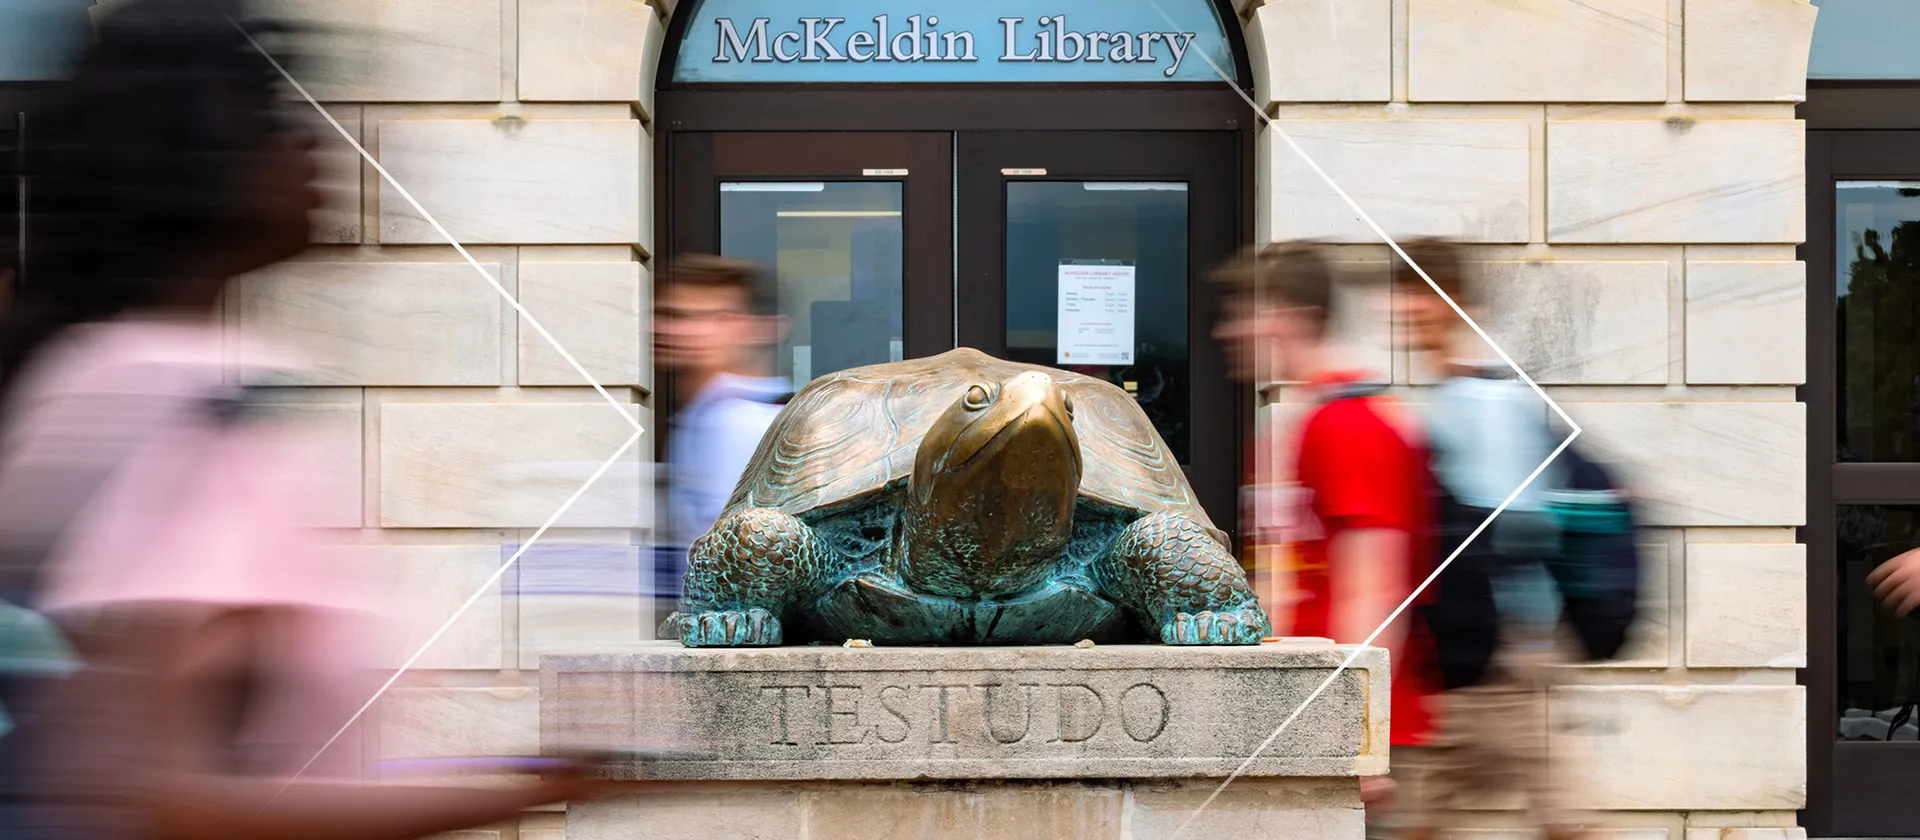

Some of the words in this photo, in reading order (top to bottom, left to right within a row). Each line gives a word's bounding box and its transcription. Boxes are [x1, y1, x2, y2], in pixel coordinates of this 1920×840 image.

[712, 14, 979, 63] McKeldin
[998, 14, 1196, 77] Library
[760, 682, 1170, 745] TESTUDO
